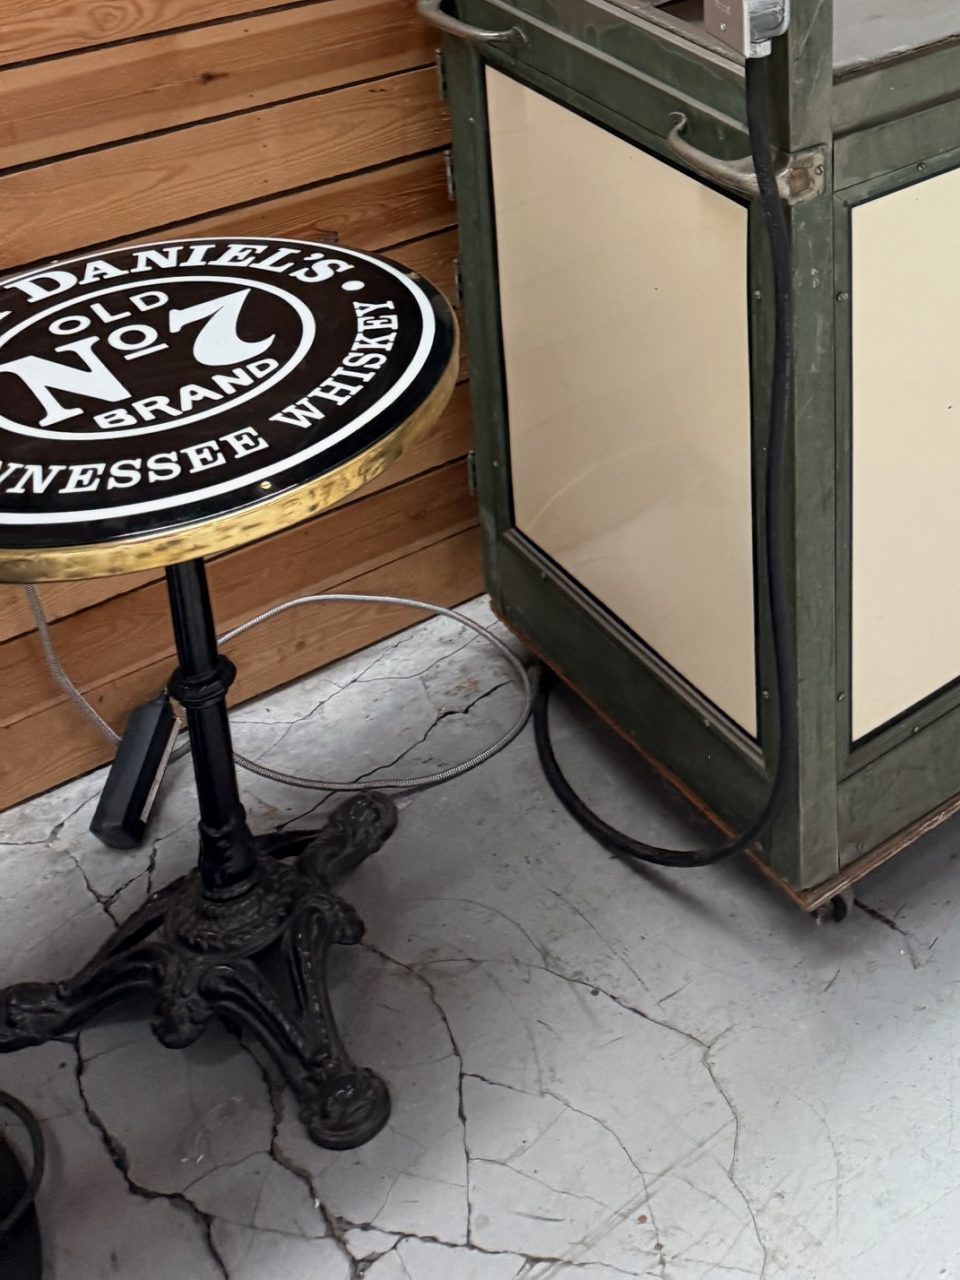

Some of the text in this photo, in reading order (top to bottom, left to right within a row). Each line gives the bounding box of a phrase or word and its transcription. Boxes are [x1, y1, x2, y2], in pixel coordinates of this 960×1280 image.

[48, 290, 169, 336] OLD
[168, 288, 276, 366] 7
[93, 358, 279, 429] BRAND
[268, 300, 399, 429] WHISKEY
